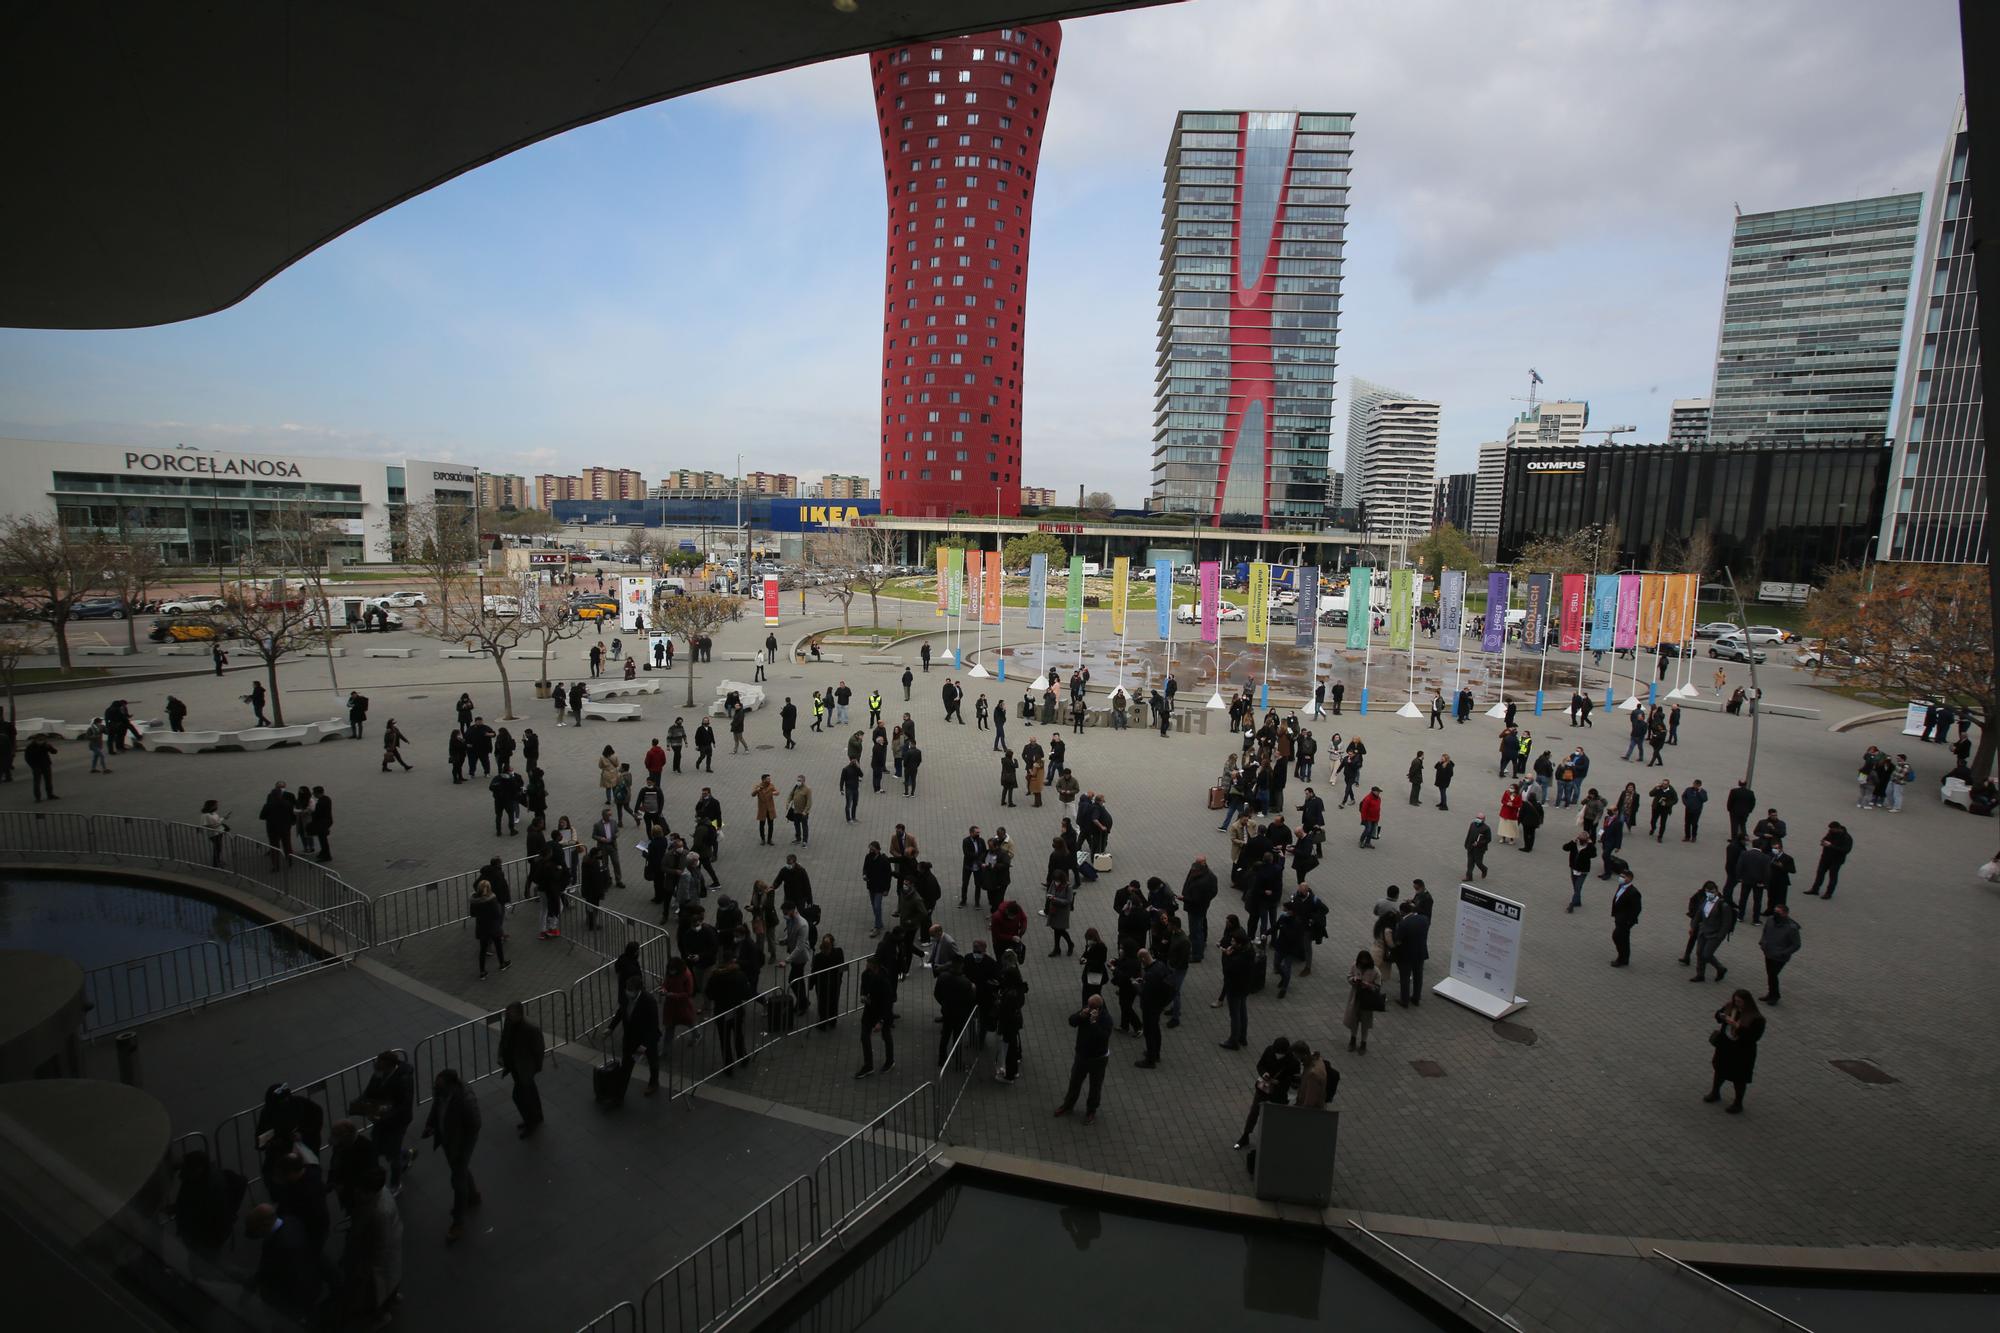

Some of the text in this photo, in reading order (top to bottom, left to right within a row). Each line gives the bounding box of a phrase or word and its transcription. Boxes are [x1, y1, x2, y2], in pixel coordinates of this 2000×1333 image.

[125, 451, 303, 478] PORCELANOSA
[1526, 461, 1586, 470] OLYMPUS
[800, 506, 860, 523] IKEA
